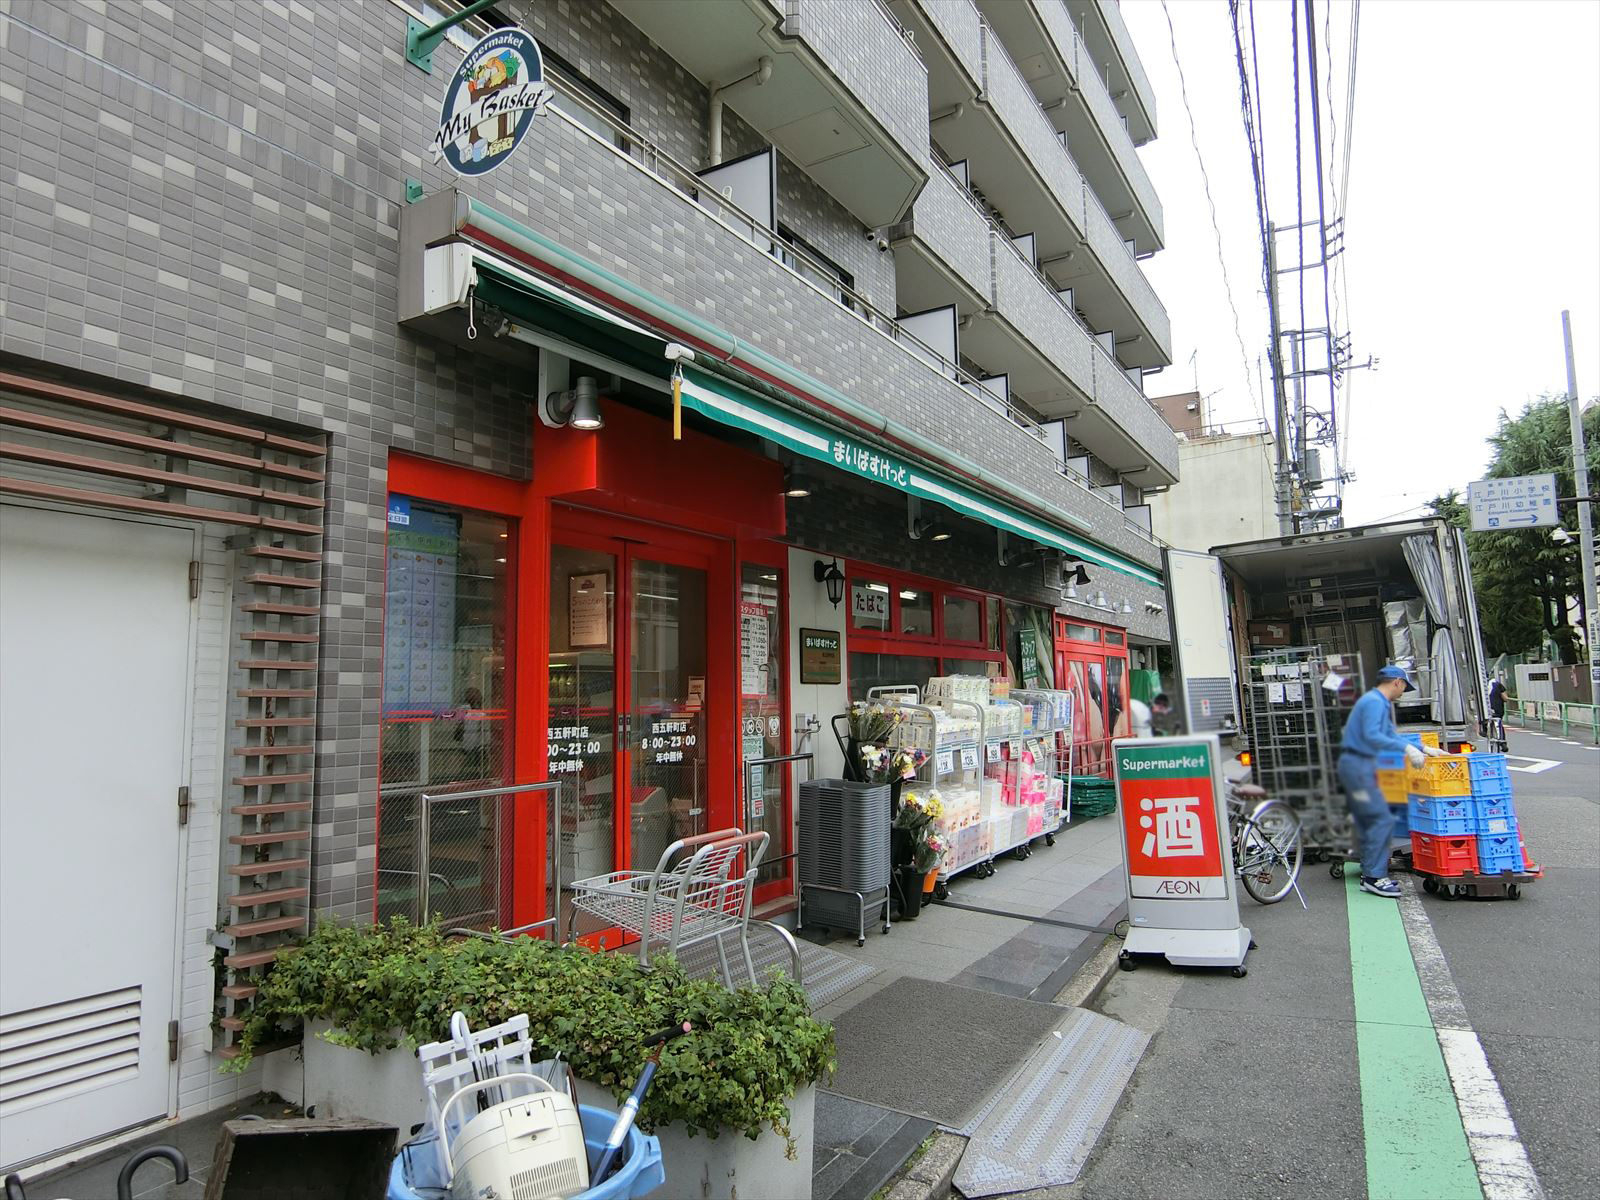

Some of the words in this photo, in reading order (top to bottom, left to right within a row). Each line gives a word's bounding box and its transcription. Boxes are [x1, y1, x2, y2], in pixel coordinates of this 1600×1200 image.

[459, 33, 524, 77] Supermarket
[434, 112, 472, 149] My
[480, 83, 544, 118] Basket
[833, 440, 907, 486] まいばすけっと
[1474, 484, 1550, 499] 江戸川小学校
[855, 592, 884, 614] たばこ
[806, 637, 838, 649] まいばすけっと
[652, 721, 687, 734] 西五軒町店
[655, 751, 684, 764] 年中無休
[1122, 755, 1206, 772] Supermarket
[549, 759, 584, 774] 年中無休
[1139, 797, 1205, 858] 酒
